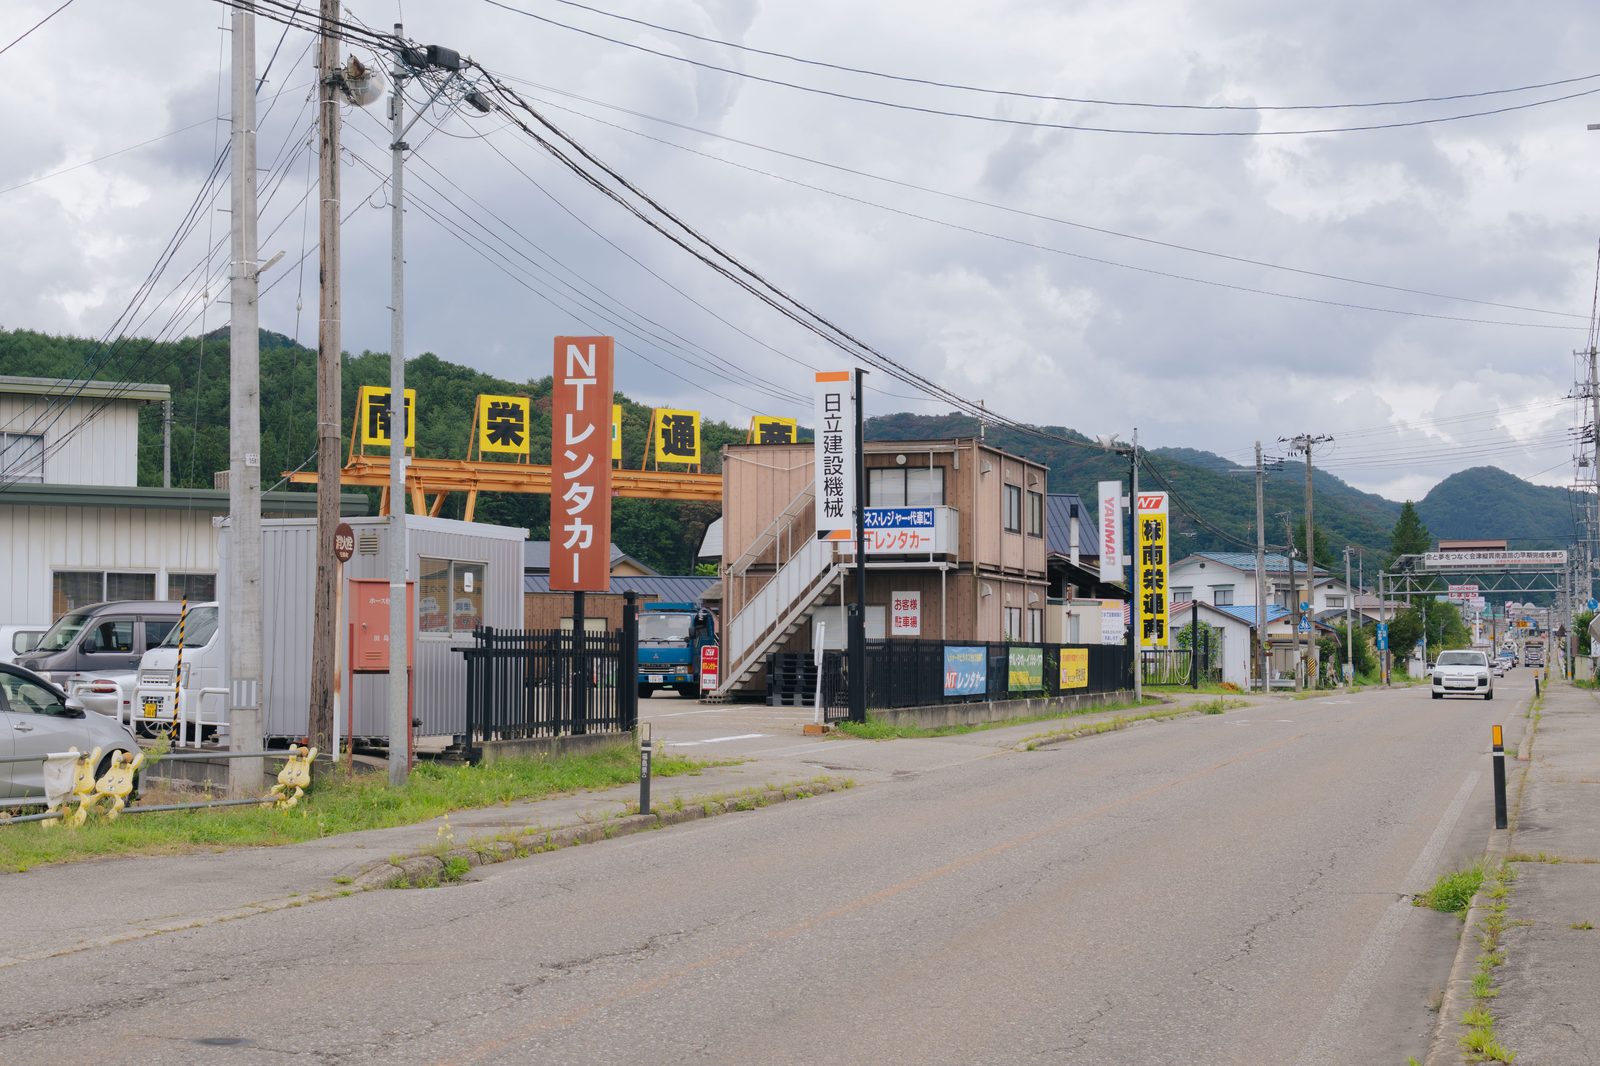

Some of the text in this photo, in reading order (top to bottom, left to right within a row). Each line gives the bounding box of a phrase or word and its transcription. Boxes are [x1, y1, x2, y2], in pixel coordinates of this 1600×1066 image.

[486, 401, 525, 447] 栄
[661, 414, 697, 457] 通
[563, 344, 597, 584] NTレンタカー
[823, 393, 845, 519] 日立建設機械
[1138, 496, 1162, 508] NT
[863, 510, 933, 526] ネス・レジャー・代車に!
[855, 530, 930, 550] Tレンタカー
[1103, 496, 1117, 567] YANMAR
[335, 535, 354, 551] 消火栓
[894, 598, 917, 611] お客様
[894, 616, 917, 628] 駐車場
